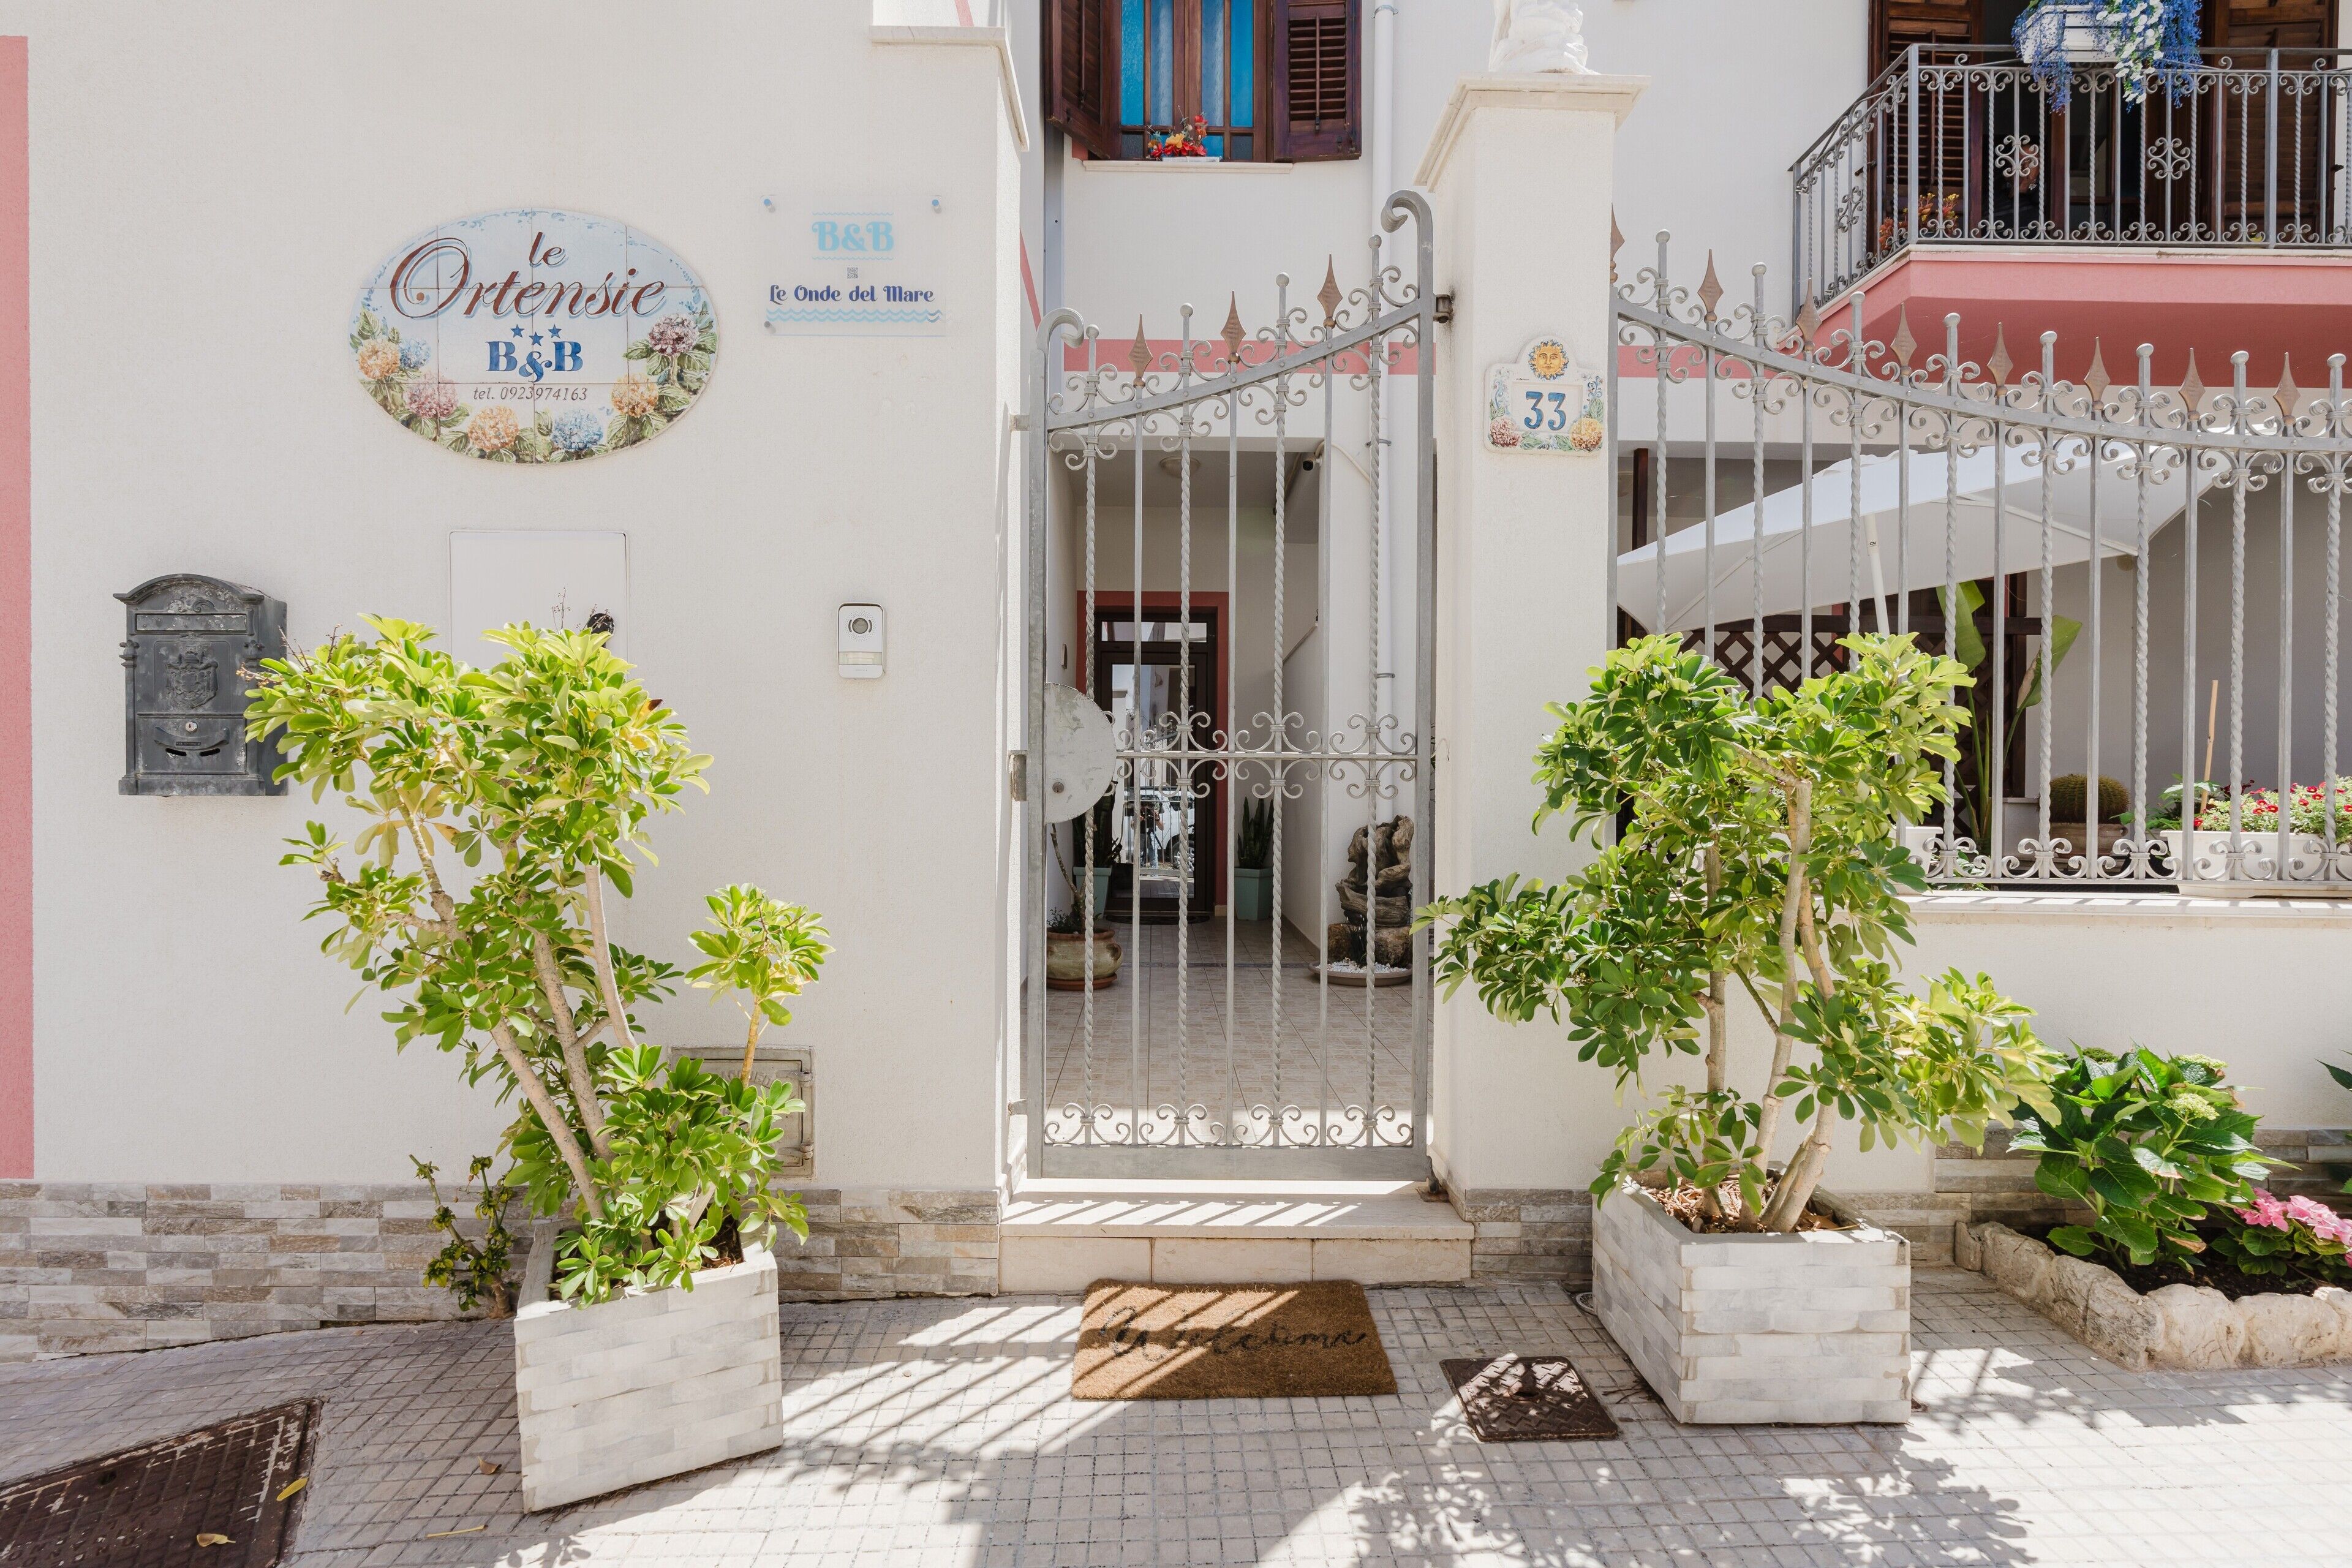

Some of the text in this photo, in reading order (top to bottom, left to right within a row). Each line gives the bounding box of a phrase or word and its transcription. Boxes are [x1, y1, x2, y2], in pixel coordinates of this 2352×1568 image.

[529, 232, 565, 266] le
[811, 221, 894, 252] B&B
[390, 237, 666, 318] Ortensie
[769, 284, 935, 305] Le Onde del Mare
[486, 341, 584, 383] B&B
[473, 386, 588, 401] tel. 0923974163
[1524, 391, 1566, 431] 33
